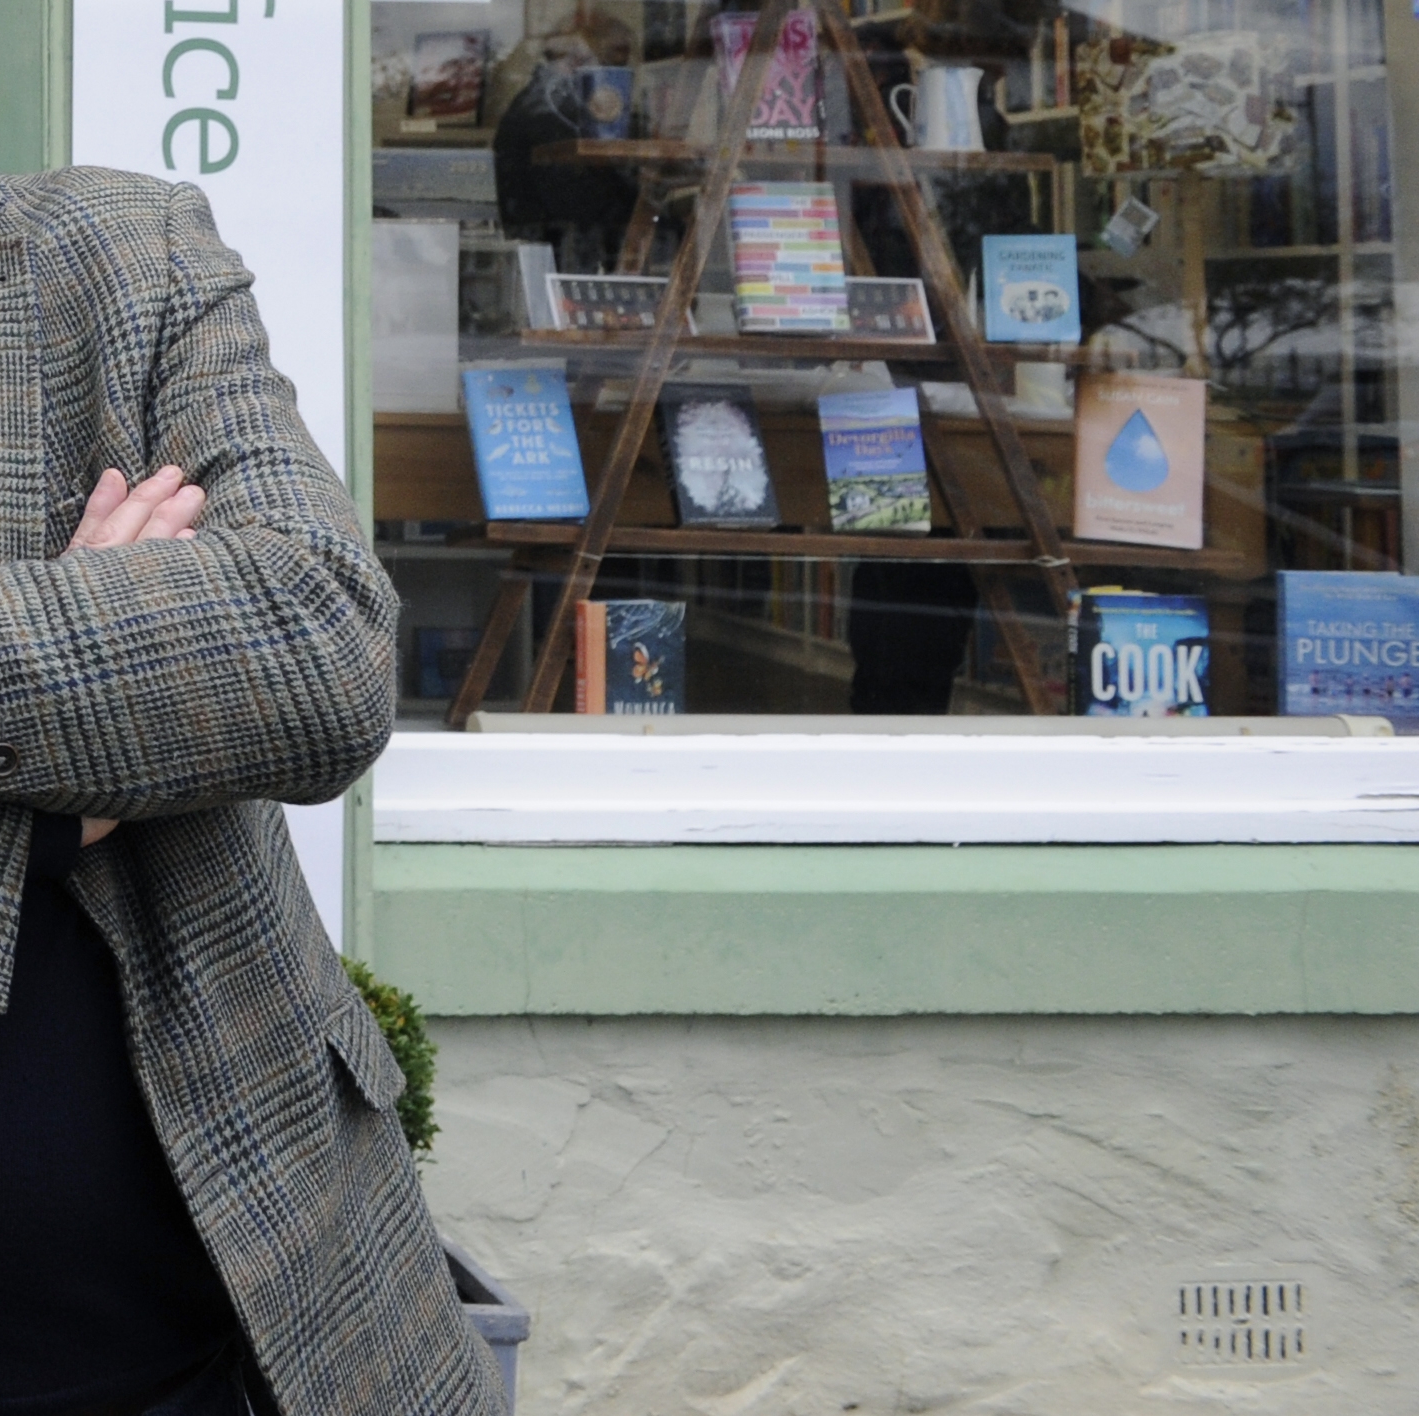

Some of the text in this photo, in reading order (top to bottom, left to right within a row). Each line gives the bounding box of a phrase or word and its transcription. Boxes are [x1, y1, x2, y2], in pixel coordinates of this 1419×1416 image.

[750, 96, 816, 126] DAY
[484, 401, 560, 418] TICKETS
[506, 418, 544, 433] FOR
[512, 435, 546, 448] THE
[513, 450, 551, 465] ARK
[689, 456, 753, 472] RESIN
[1308, 619, 1416, 640] TAKING THE
[1091, 642, 1204, 704] COOK
